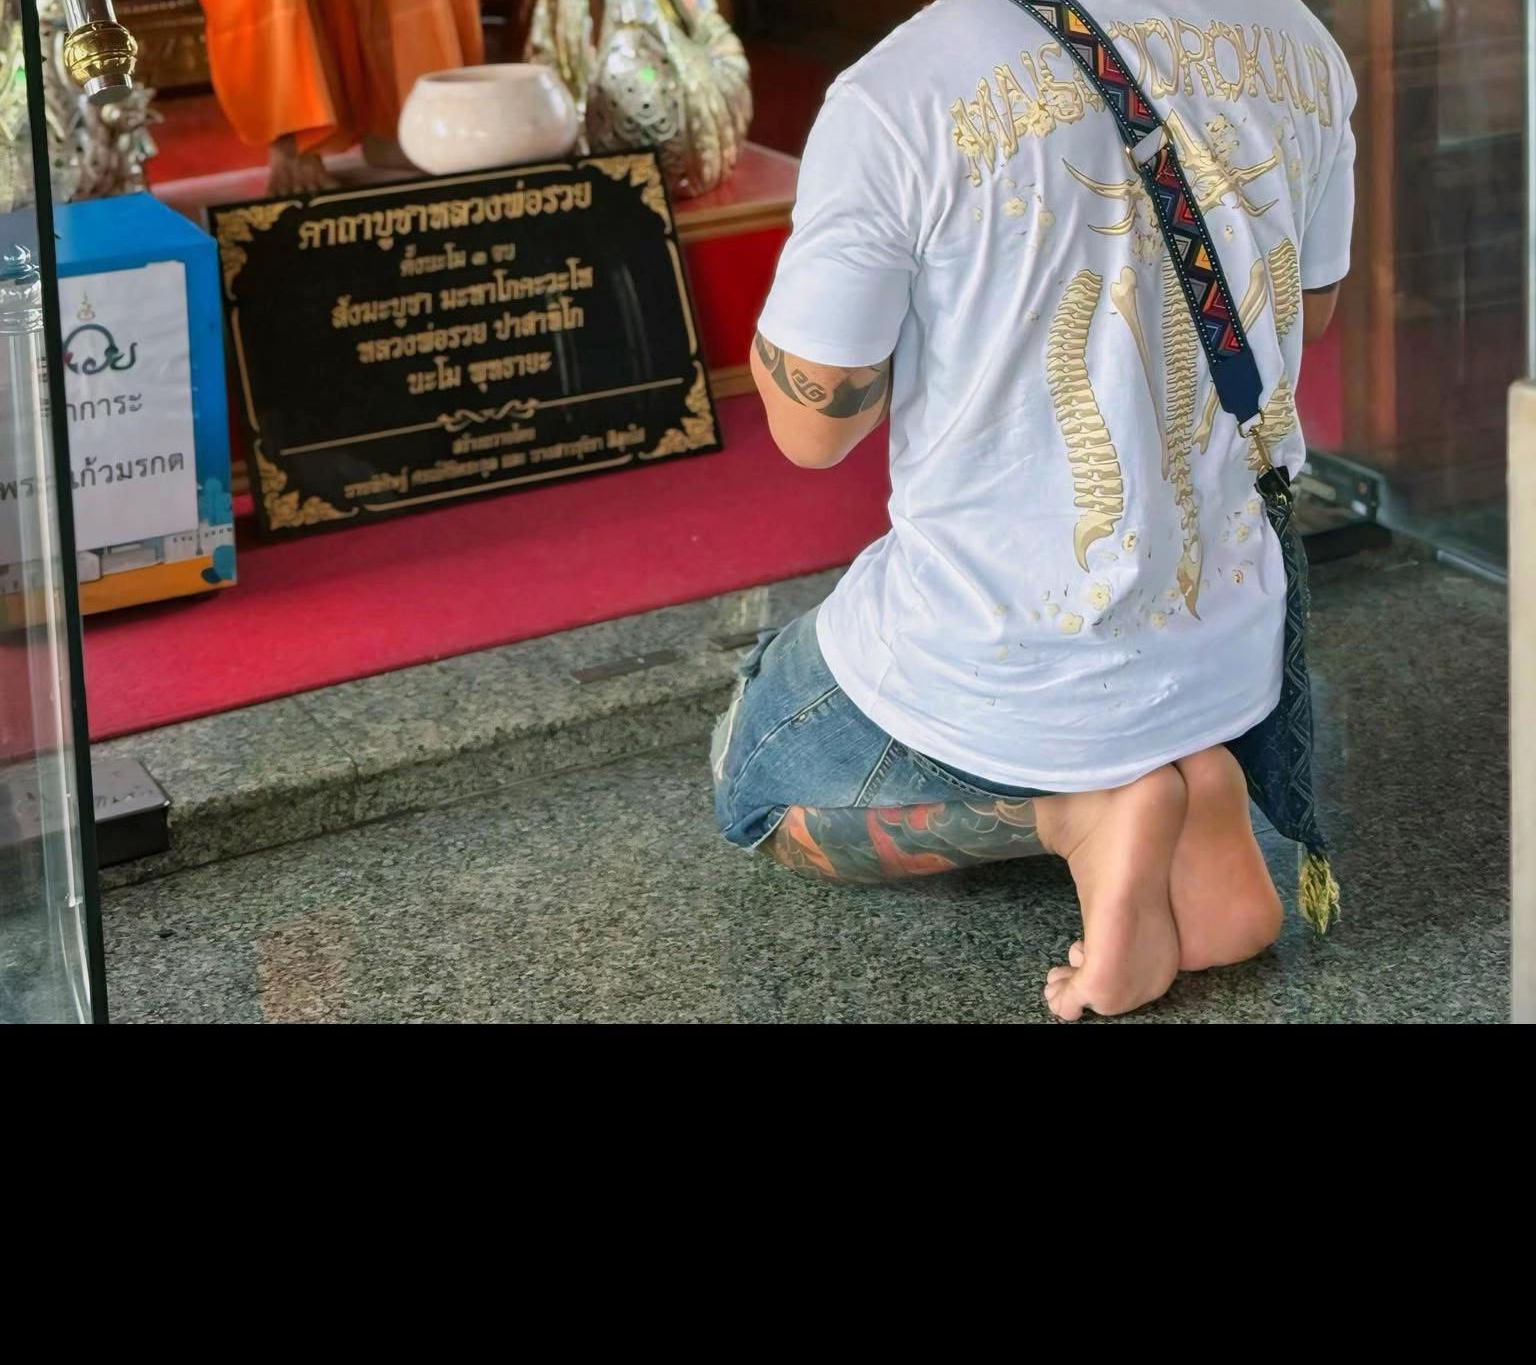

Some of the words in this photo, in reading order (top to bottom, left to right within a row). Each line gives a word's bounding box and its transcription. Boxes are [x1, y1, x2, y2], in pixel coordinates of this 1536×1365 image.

[299, 181, 592, 250] คาถาบูชาหลวงพ่อรวย
[357, 316, 488, 365] หลวงพ่อรวย
[406, 355, 461, 395] นะโม
